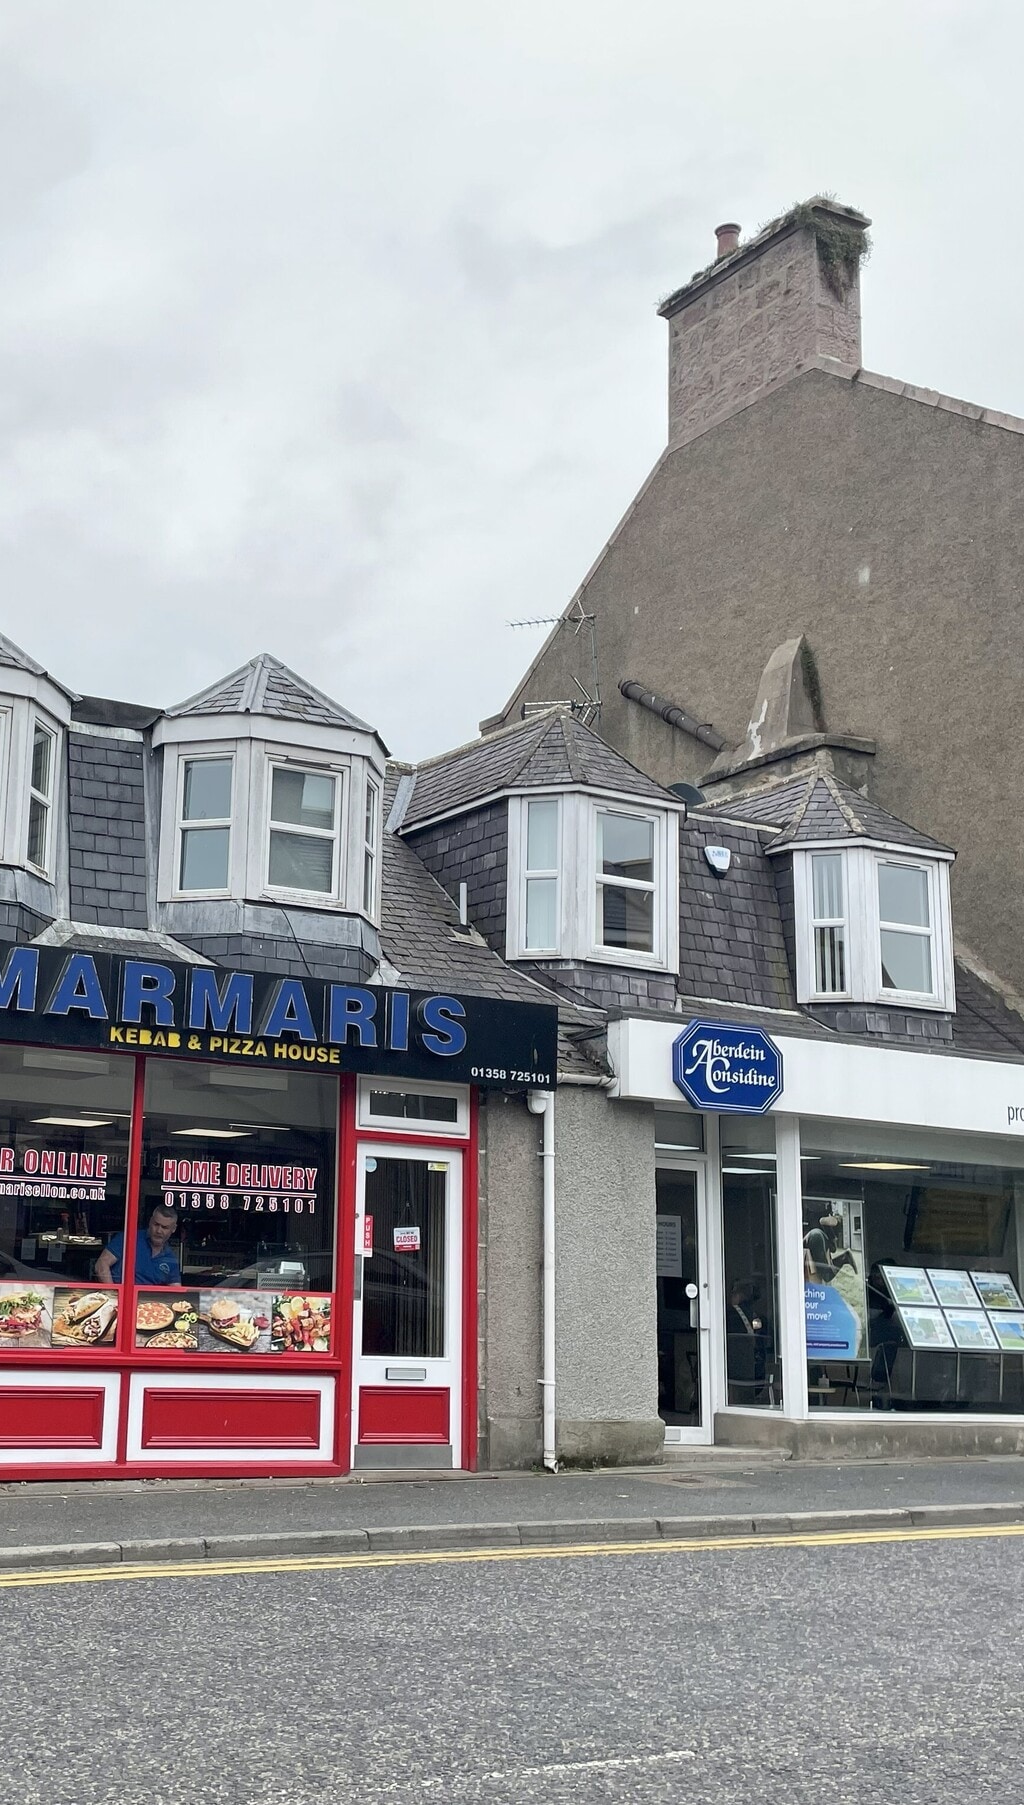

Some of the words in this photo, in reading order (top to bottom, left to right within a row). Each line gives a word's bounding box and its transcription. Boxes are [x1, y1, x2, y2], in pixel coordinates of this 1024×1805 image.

[110, 1026, 181, 1049] KEBAB
[187, 1033, 202, 1051] &
[209, 1036, 267, 1057] PIZZA
[274, 1043, 341, 1064] HOUSE
[685, 1039, 766, 1075] Aberdein
[471, 1066, 507, 1081] 01358
[510, 1069, 551, 1084] 725101
[706, 1057, 776, 1093] Considine
[24, 1148, 108, 1178] ONLINE
[163, 1159, 221, 1186] HOME
[226, 1162, 317, 1191] DELIVERY
[164, 1191, 229, 1210] 01358
[243, 1195, 316, 1214] 725101
[396, 1235, 418, 1243] CLOSED
[807, 1310, 832, 1321] move?
